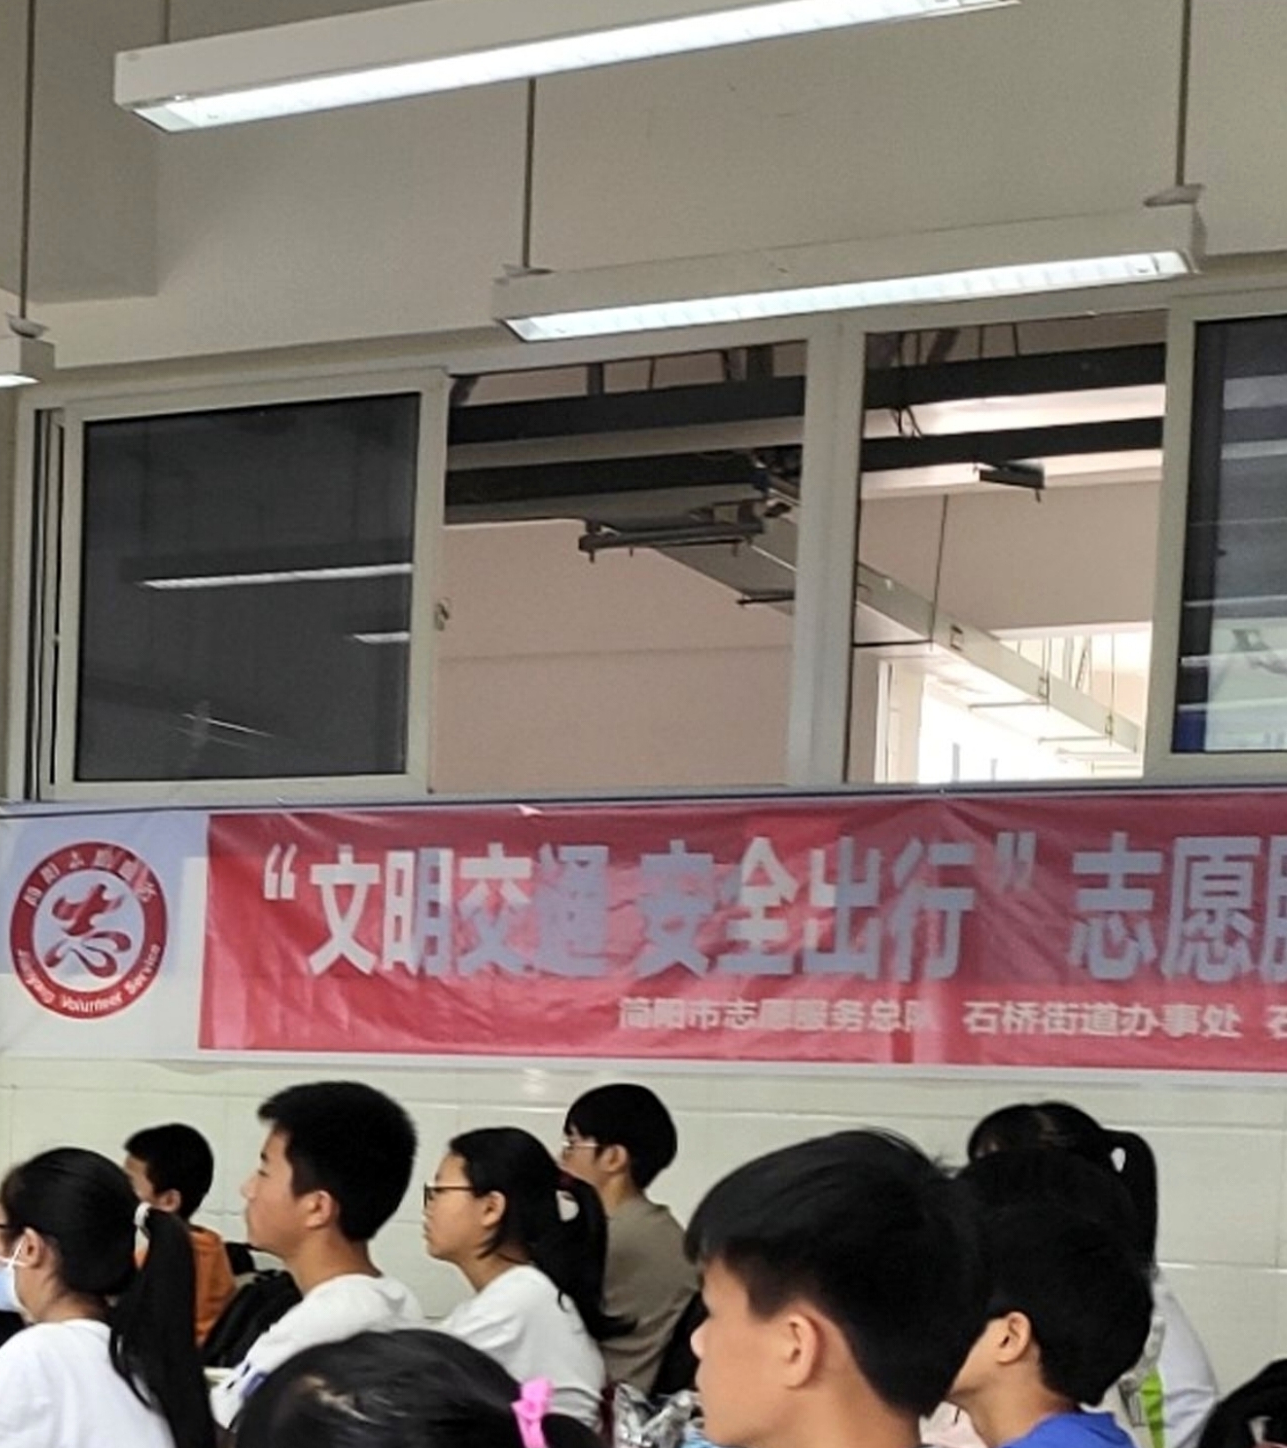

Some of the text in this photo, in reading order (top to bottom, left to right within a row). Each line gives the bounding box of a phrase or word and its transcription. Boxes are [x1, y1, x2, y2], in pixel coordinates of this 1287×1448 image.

[962, 1000, 1243, 1039] 石桥街道办事处
